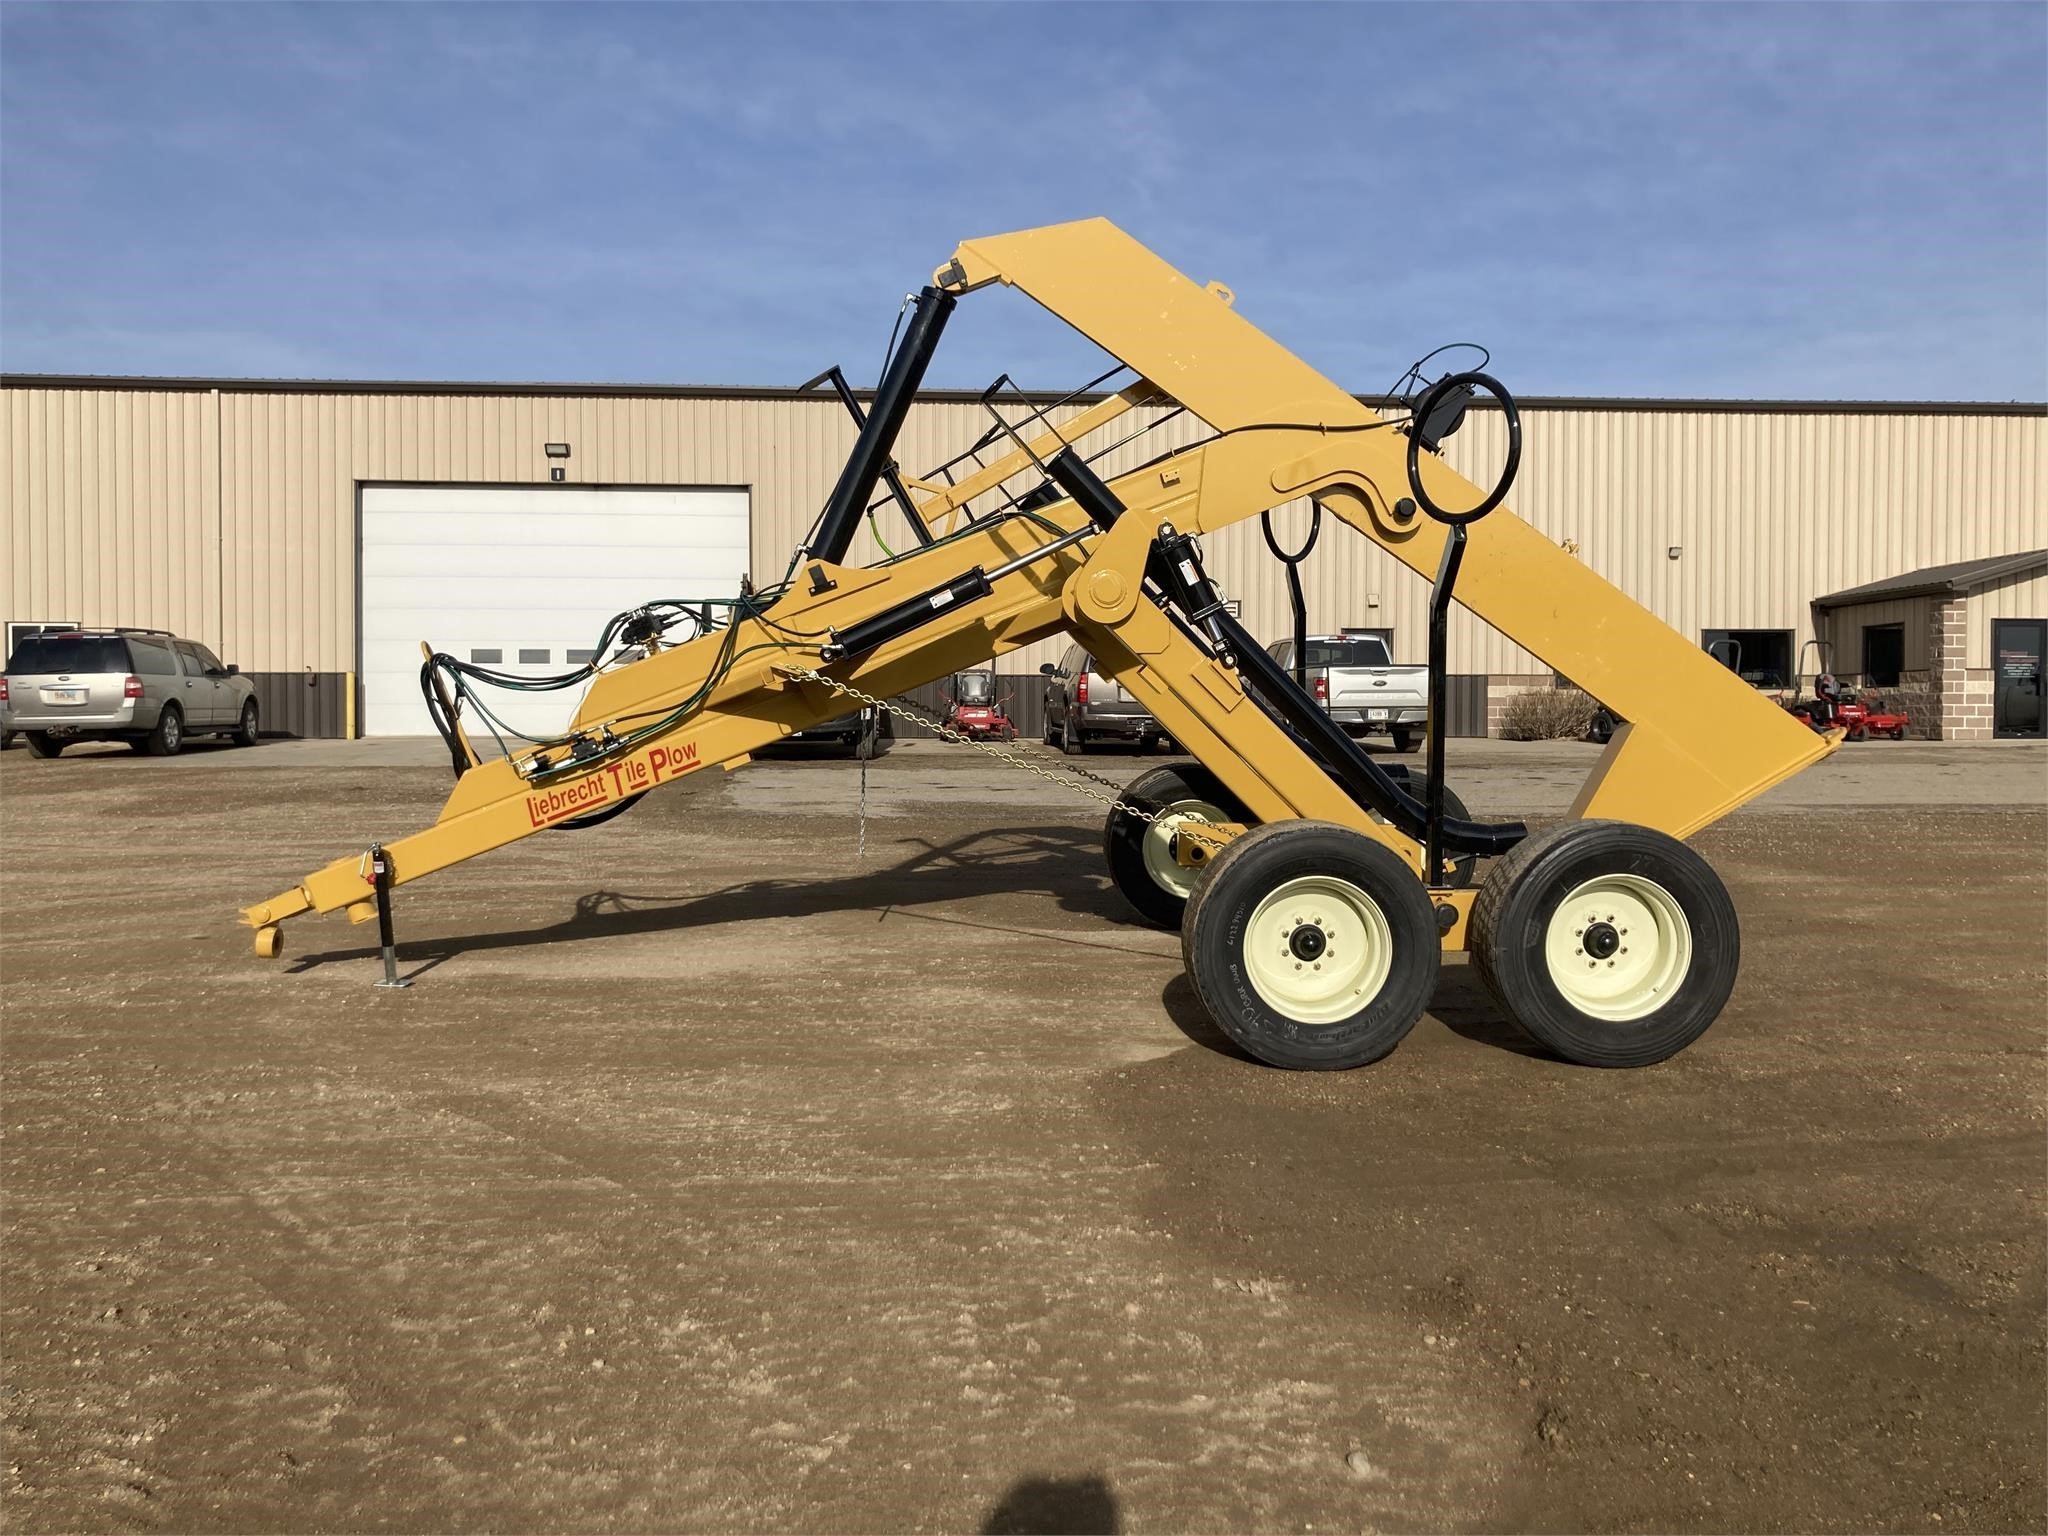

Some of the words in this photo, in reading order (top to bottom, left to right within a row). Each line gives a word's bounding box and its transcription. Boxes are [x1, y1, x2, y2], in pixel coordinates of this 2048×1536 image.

[526, 774, 607, 828] Liebrecht
[607, 762, 647, 797] Tile
[648, 742, 698, 783] Plow
